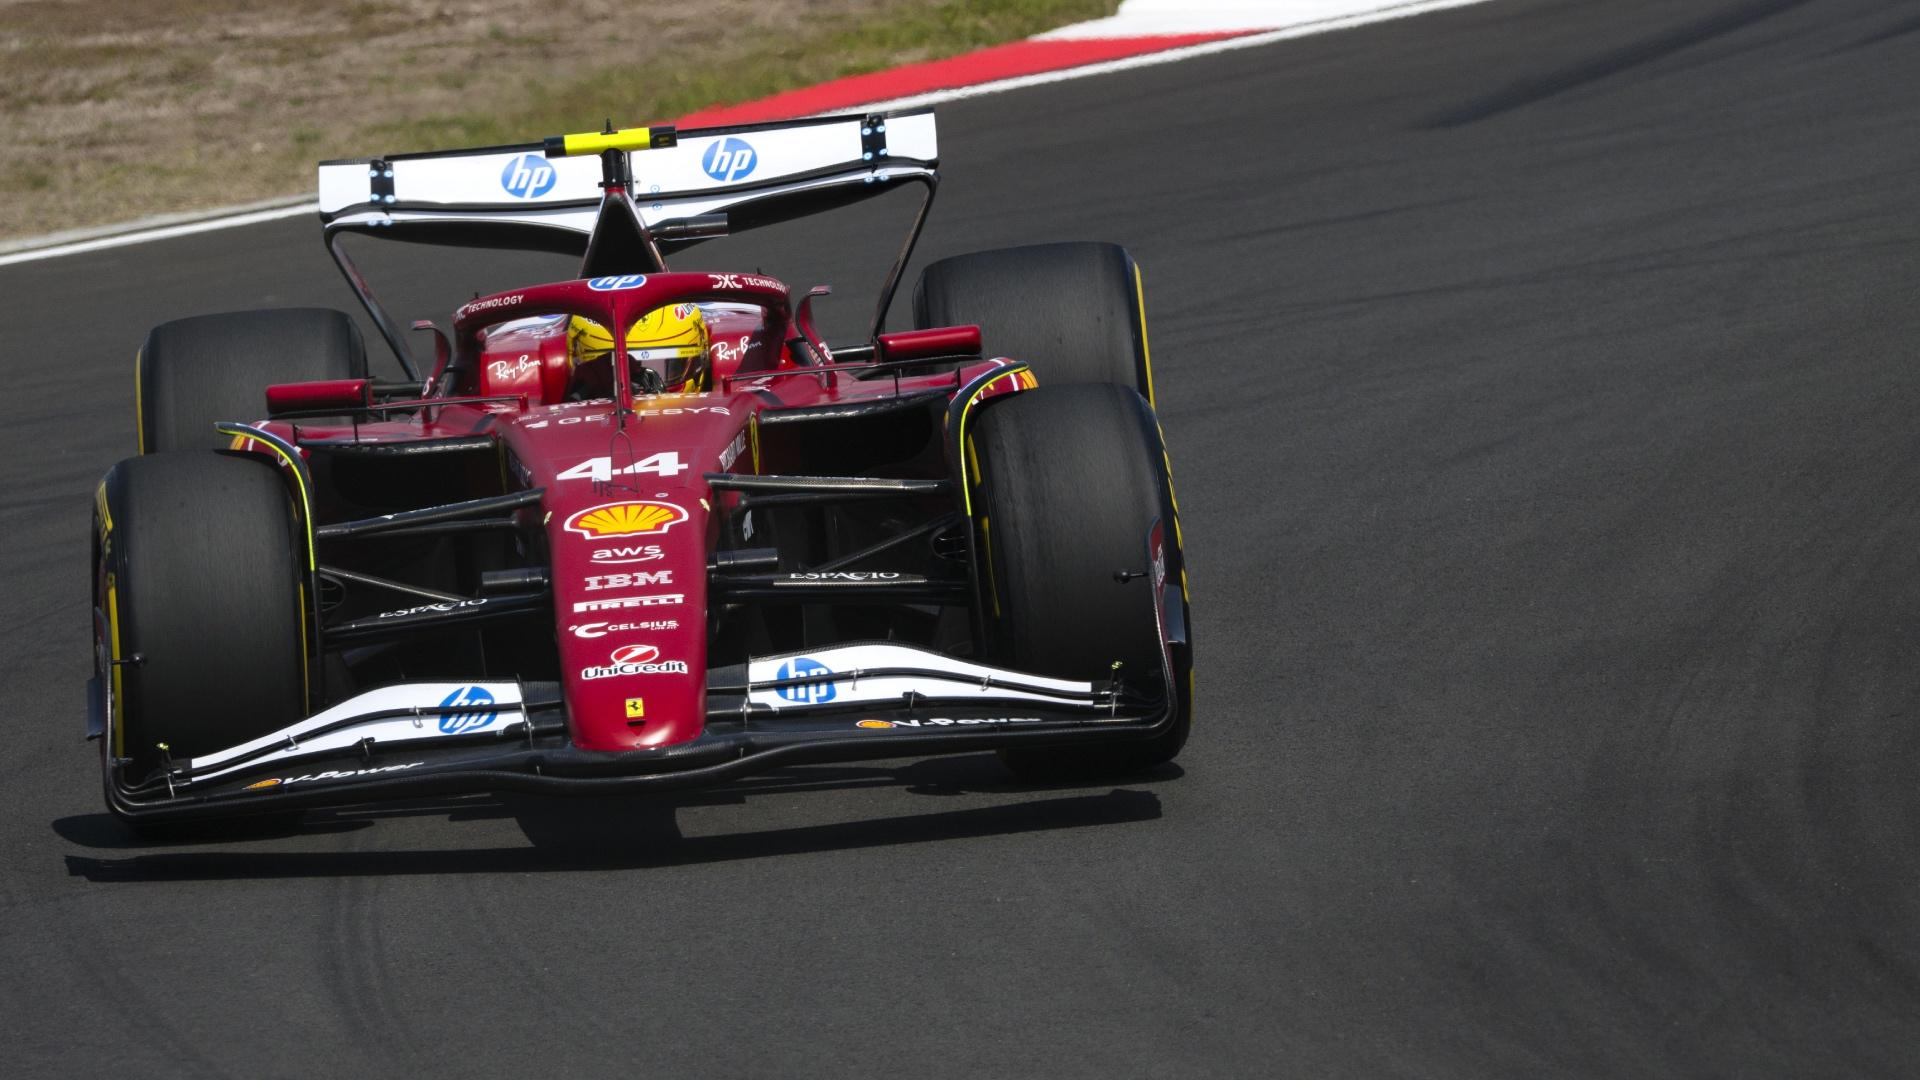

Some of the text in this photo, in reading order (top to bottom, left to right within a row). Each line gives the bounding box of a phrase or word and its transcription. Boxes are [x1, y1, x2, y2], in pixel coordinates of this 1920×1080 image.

[708, 138, 750, 182] hp
[507, 155, 550, 199] hp
[595, 275, 639, 290] hp
[708, 274, 743, 289] DXC
[467, 294, 525, 314] TECHNOLOGY
[709, 336, 763, 361] Ray-Ban
[487, 354, 542, 379] Ray-Ban
[556, 451, 689, 481] 44
[591, 545, 662, 560] aws
[584, 570, 673, 592] IBM
[573, 593, 685, 613] PIRELLI
[607, 620, 679, 631] CELSIUS
[583, 661, 686, 680] UniCredit
[786, 657, 829, 704] hp
